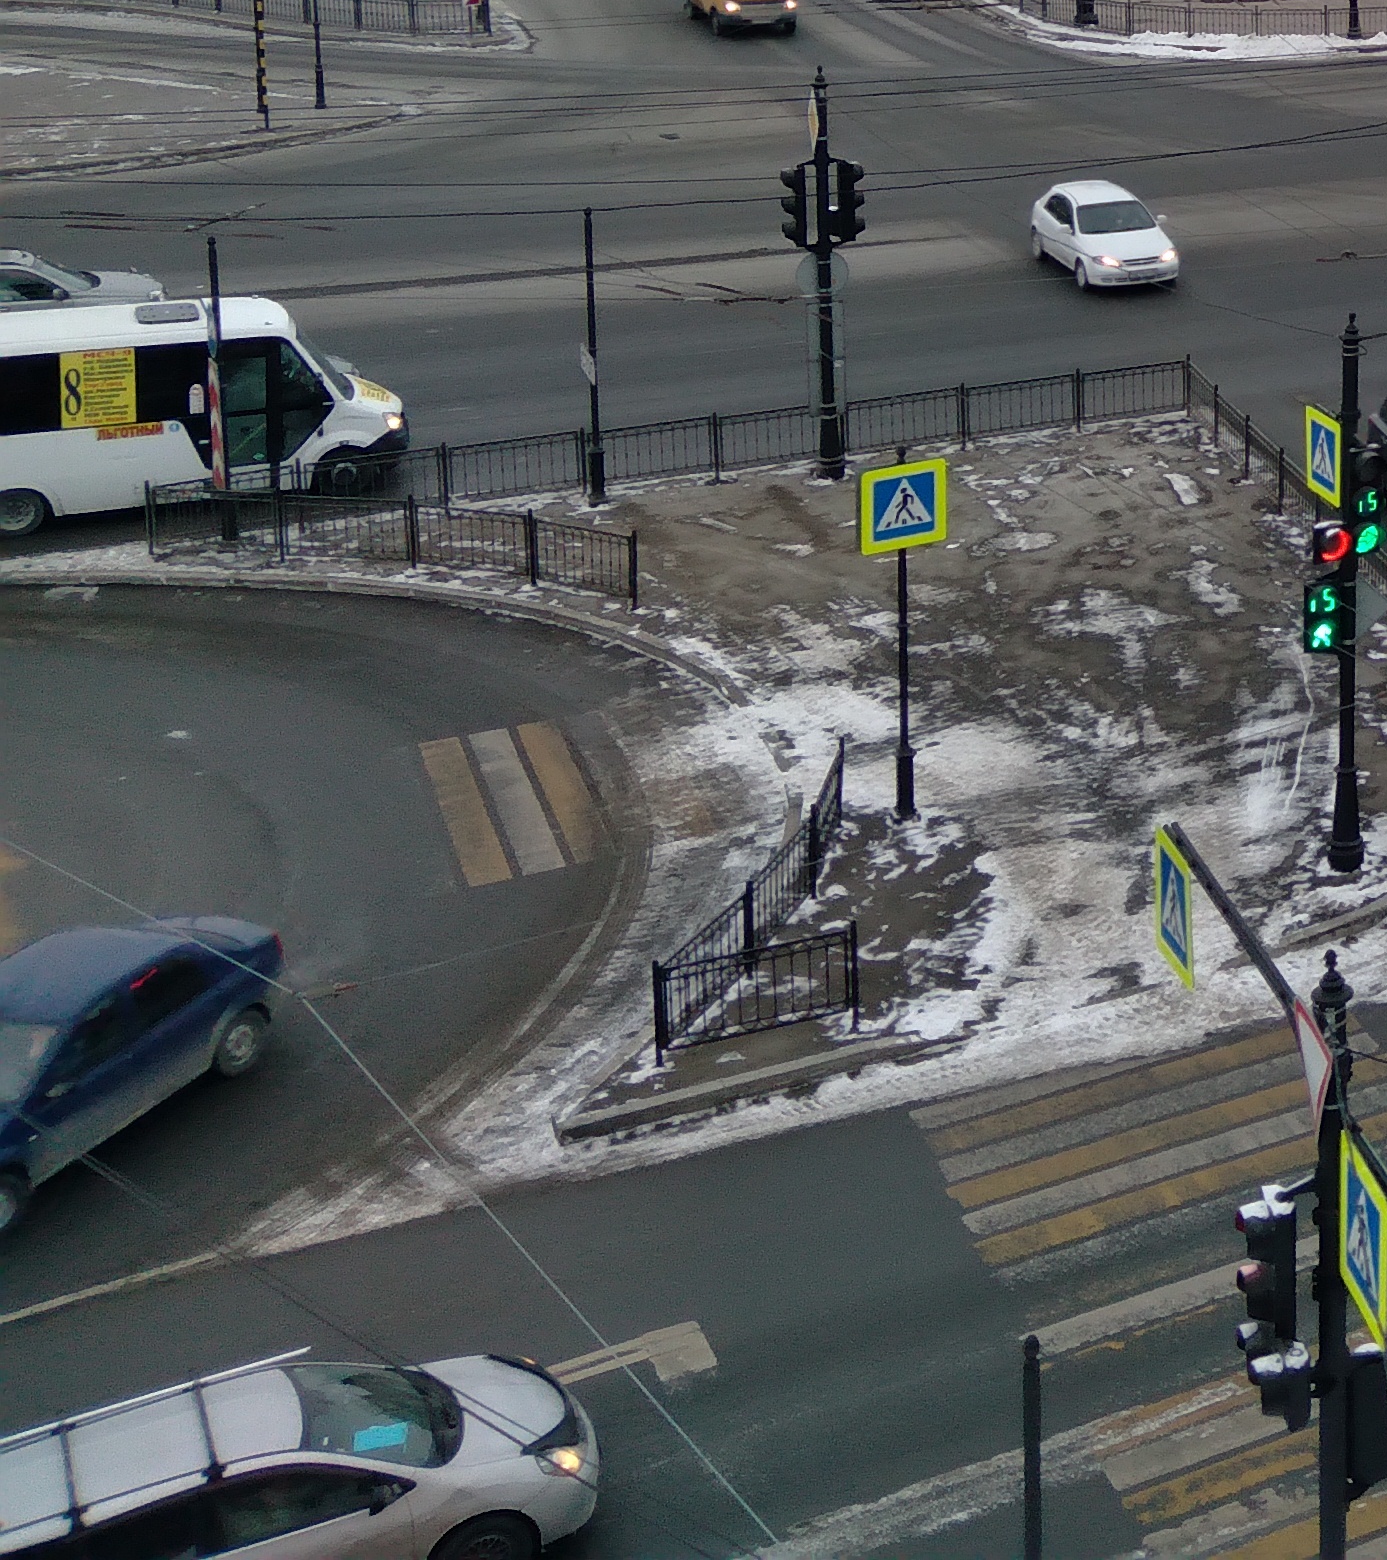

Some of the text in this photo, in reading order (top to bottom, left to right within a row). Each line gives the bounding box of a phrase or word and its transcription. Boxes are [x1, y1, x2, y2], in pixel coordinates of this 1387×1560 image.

[64, 368, 82, 416] 8
[97, 422, 164, 441] ЛЬГОТНЫЙ
[1359, 491, 1377, 513] 15
[1310, 588, 1336, 613] 15
